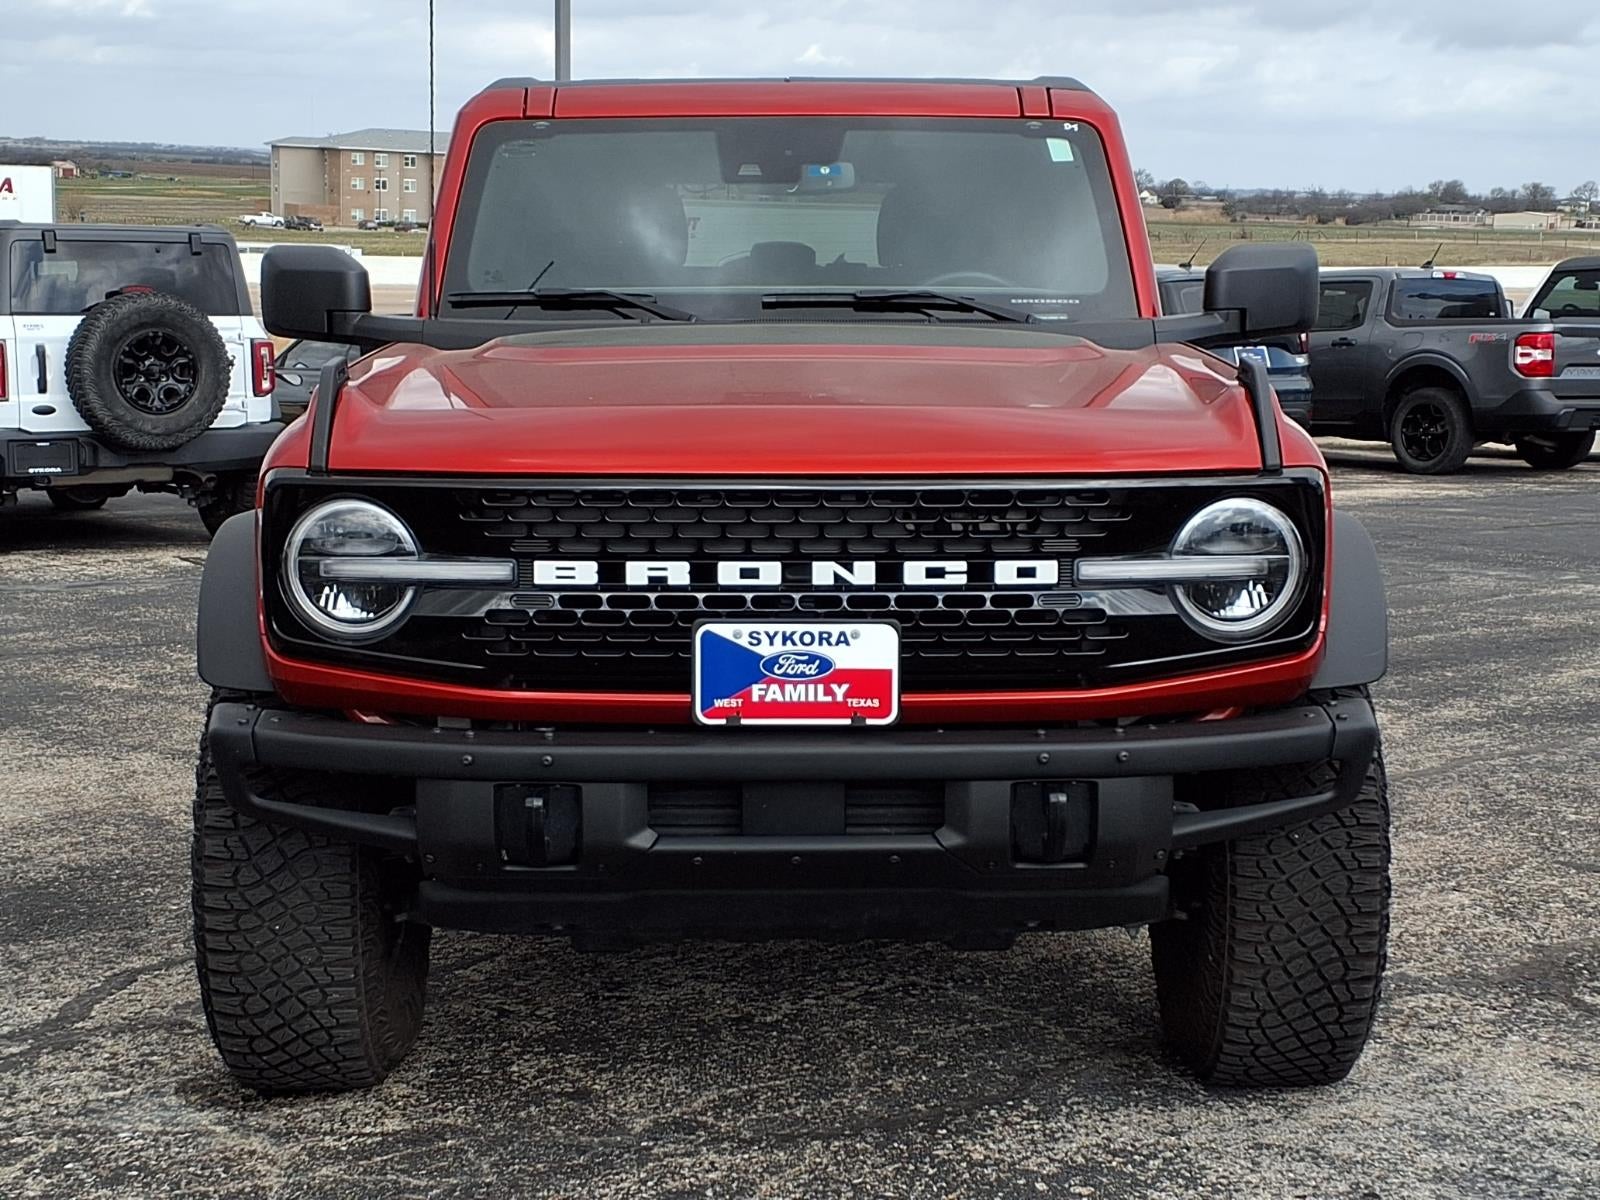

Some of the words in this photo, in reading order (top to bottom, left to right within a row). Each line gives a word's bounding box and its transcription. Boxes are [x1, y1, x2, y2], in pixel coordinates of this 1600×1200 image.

[533, 560, 1059, 587] BRONCO
[747, 630, 851, 647] SYKORA
[773, 654, 820, 676] Ford
[751, 683, 850, 703] FAMILY
[713, 698, 744, 708] WEST
[846, 698, 880, 708] TEXAS
